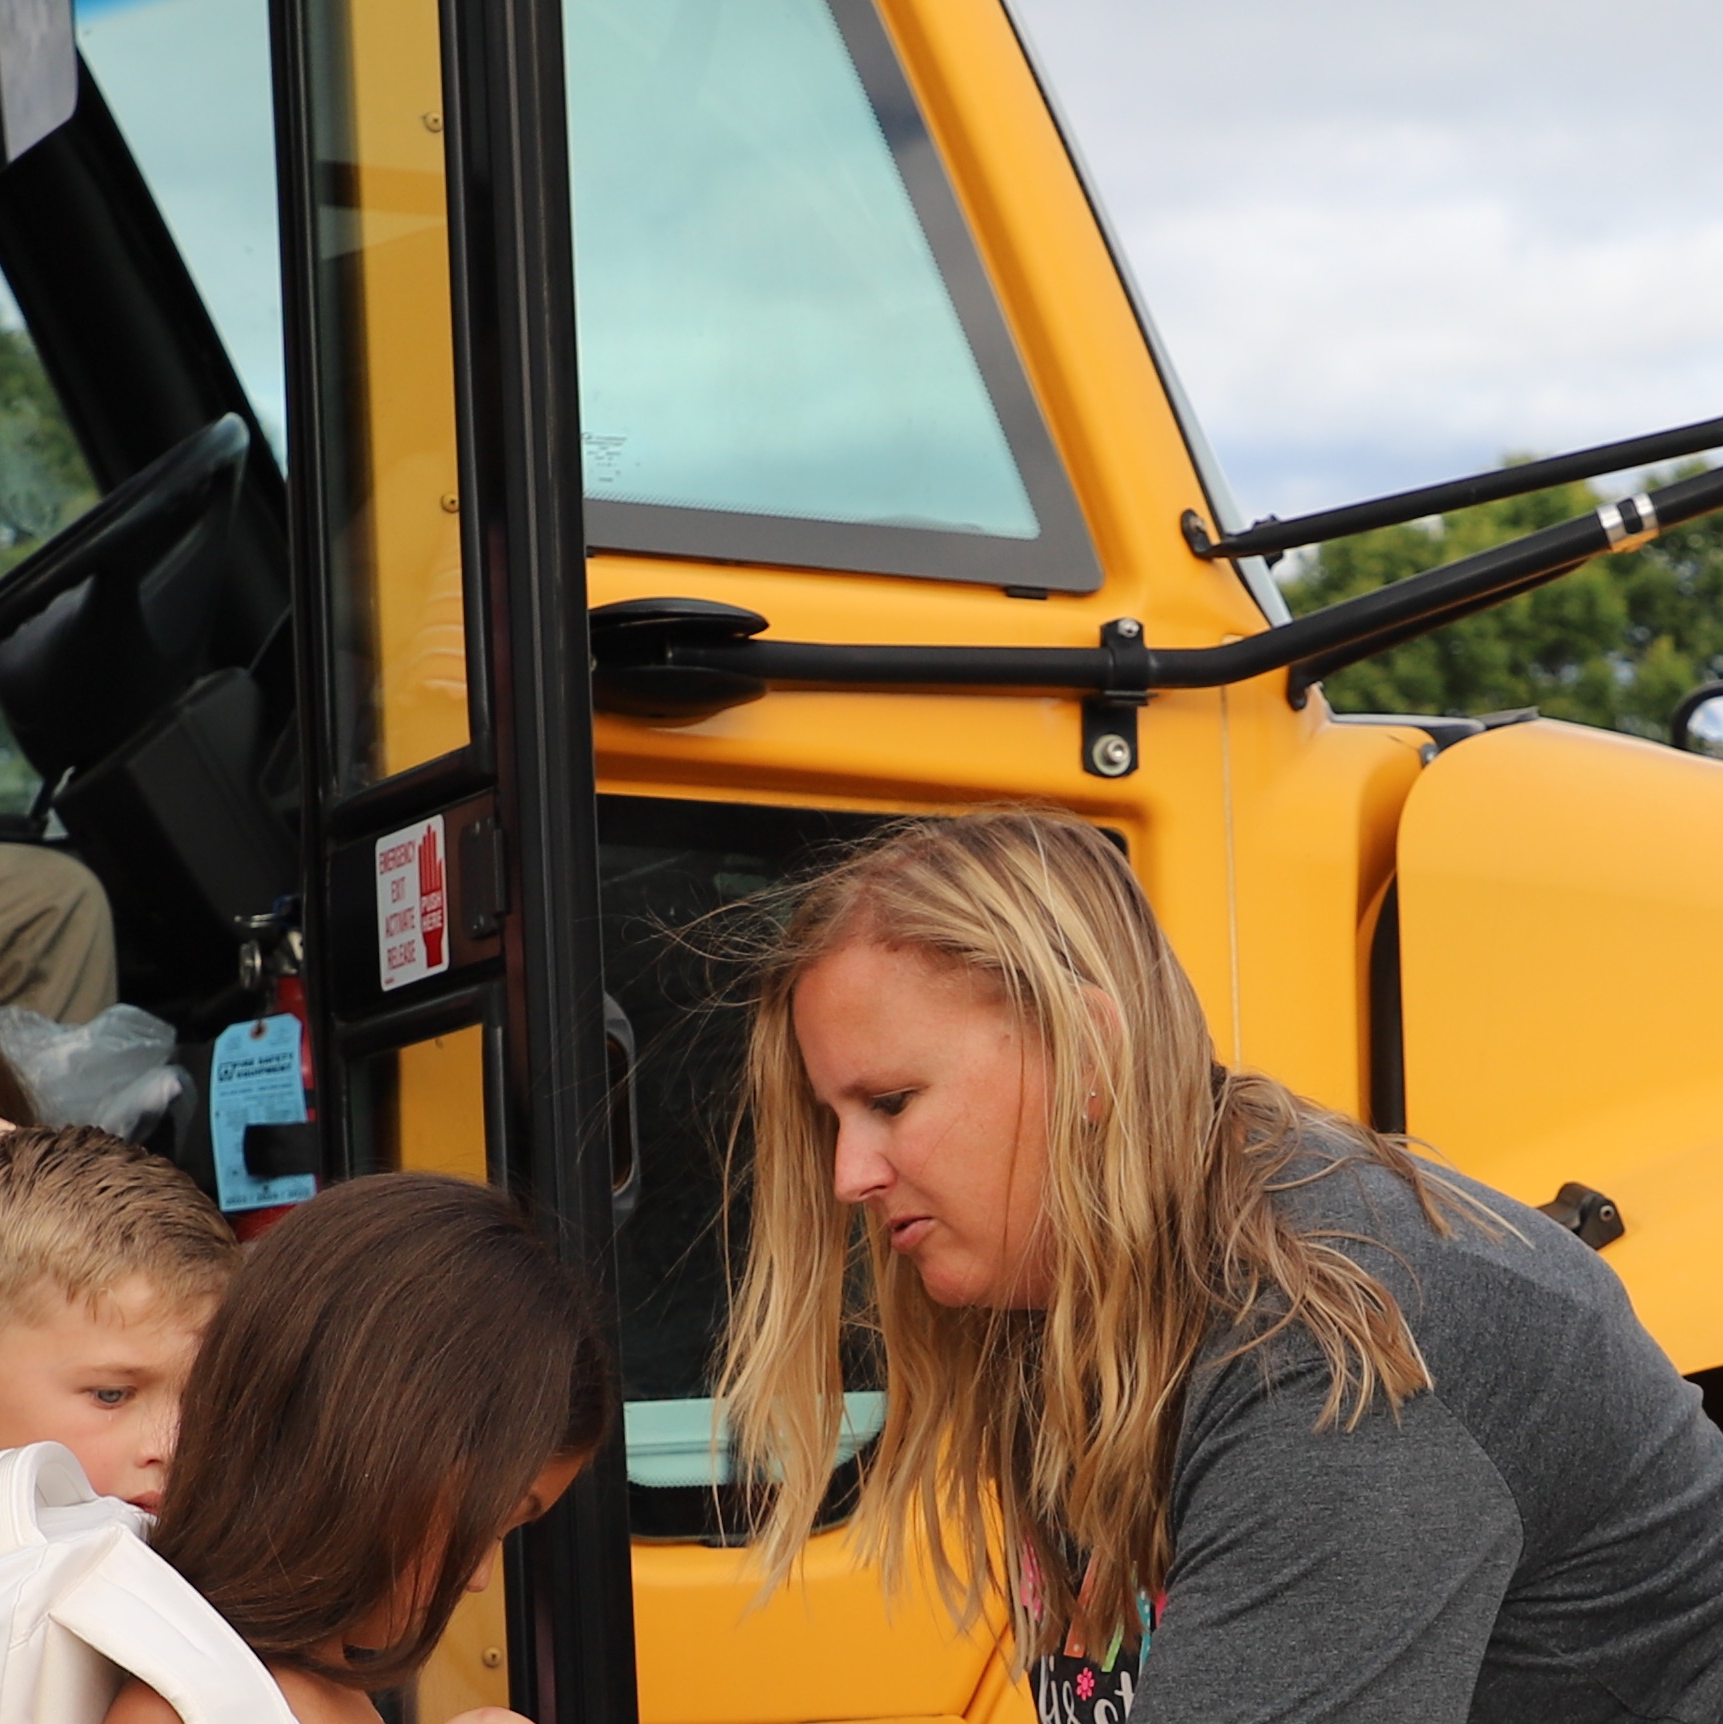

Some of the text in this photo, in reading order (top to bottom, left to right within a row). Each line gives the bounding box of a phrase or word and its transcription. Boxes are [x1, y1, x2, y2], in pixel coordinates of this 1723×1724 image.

[379, 840, 415, 875] EMERGENCY
[392, 877, 405, 903] EXIT
[422, 890, 442, 914] PUSH
[386, 907, 415, 938] ACTIVATE
[422, 909, 443, 932] HERE
[388, 940, 415, 970] RELEASE
